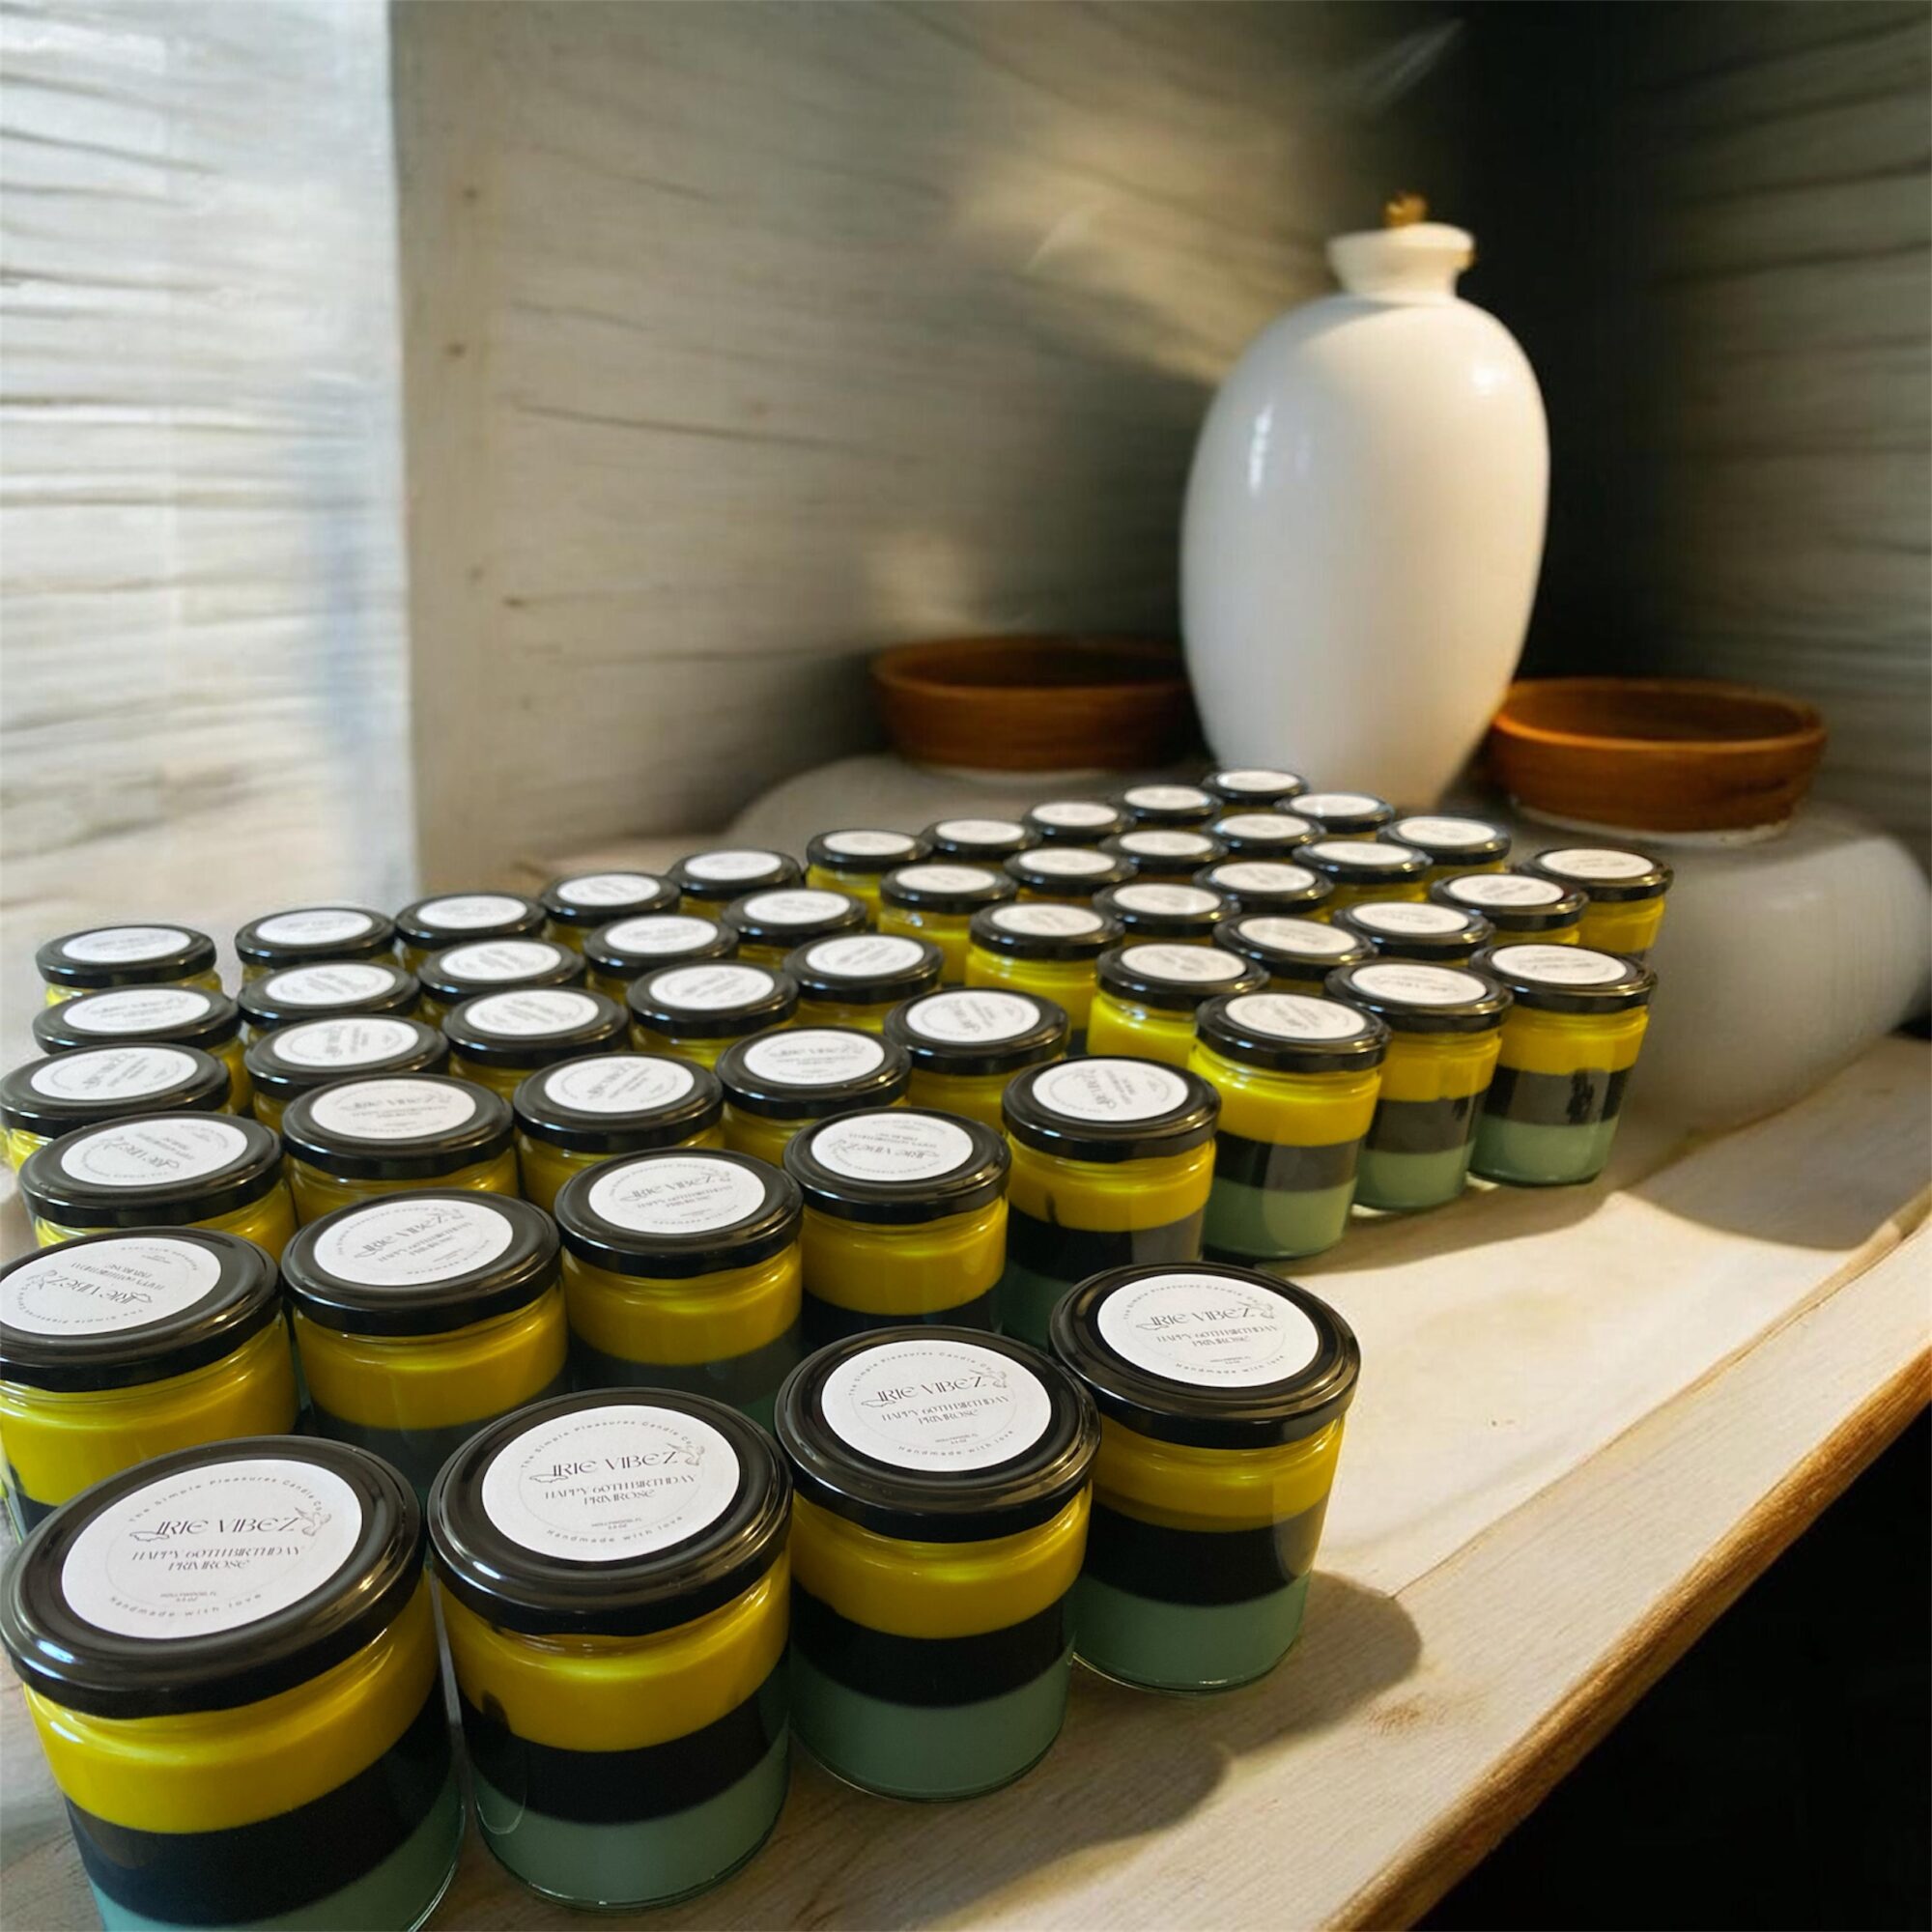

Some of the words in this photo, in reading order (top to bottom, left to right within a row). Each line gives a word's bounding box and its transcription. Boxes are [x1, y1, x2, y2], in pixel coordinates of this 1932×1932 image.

[1151, 1313, 1190, 1325] IRIE
[1191, 1308, 1254, 1321] VIBEZ
[877, 1386, 918, 1402] IRIE
[921, 1377, 986, 1394] VIBEZ
[882, 1408, 919, 1421] HAPPY
[918, 1409, 979, 1425] PRIMROSE
[574, 1420, 636, 1432] Pleasures
[642, 1421, 678, 1436] Candle
[969, 1443, 991, 1453] with
[554, 1461, 597, 1476] IRIE
[605, 1452, 678, 1469] VIBEZ
[283, 1480, 314, 1499] Candle
[545, 1488, 587, 1499] HAPPY
[584, 1490, 655, 1505] PRIMROSE
[156, 1520, 209, 1535] IRIE
[219, 1517, 298, 1533] VIBEZ
[623, 1530, 652, 1540] with
[131, 1549, 179, 1561] HAPPY
[168, 1560, 250, 1571] PRIMROSE
[185, 1606, 218, 1616] with
